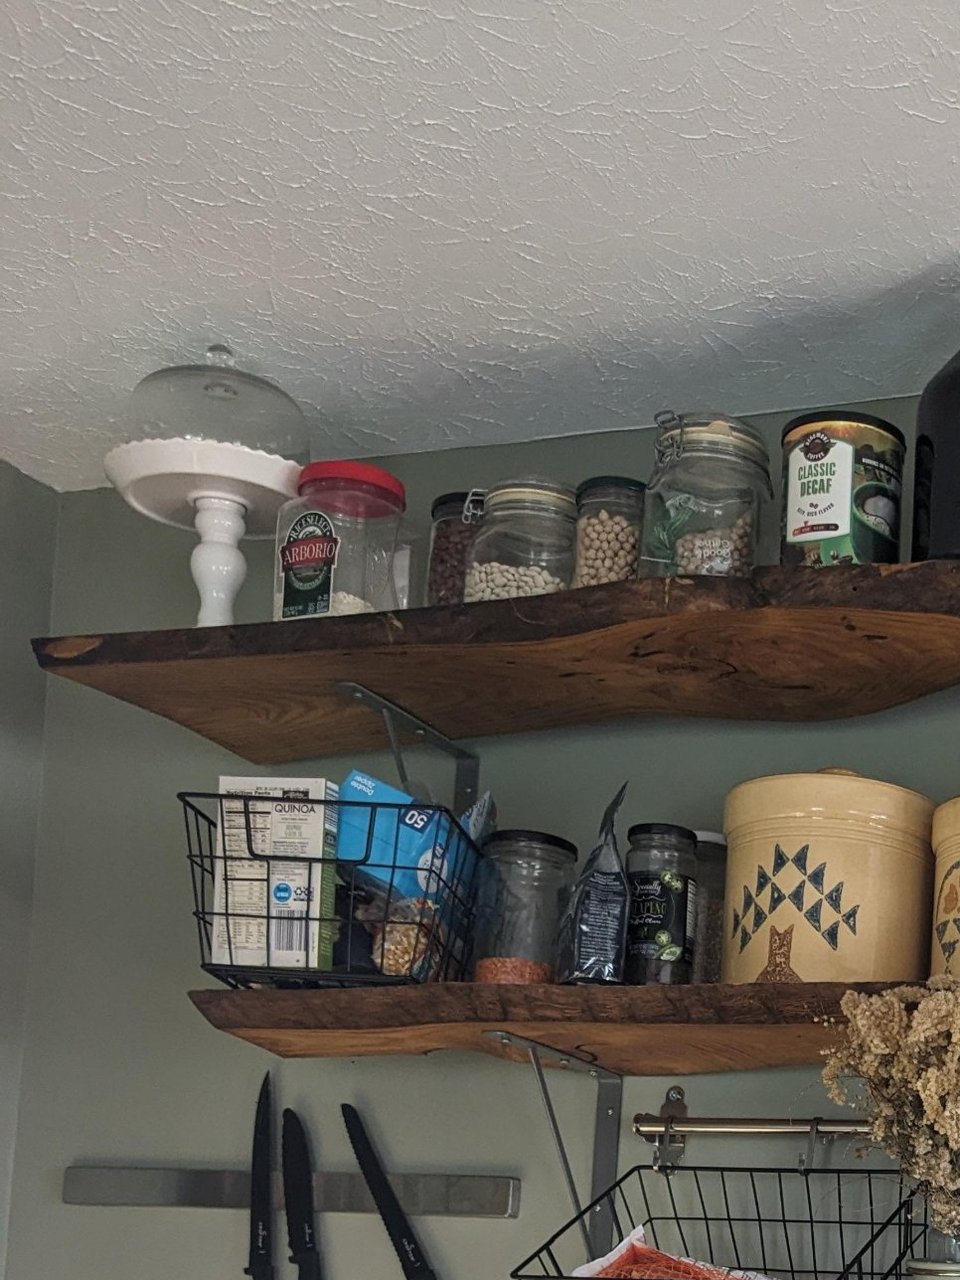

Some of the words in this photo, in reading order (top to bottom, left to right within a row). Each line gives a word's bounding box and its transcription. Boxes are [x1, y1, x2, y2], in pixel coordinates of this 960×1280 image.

[798, 462, 836, 481] CLASSIC
[801, 478, 832, 498] DECAF
[285, 543, 335, 564] ARBORIO
[350, 781, 374, 796] Double
[274, 803, 316, 813] QUINOA
[405, 810, 427, 829] 50
